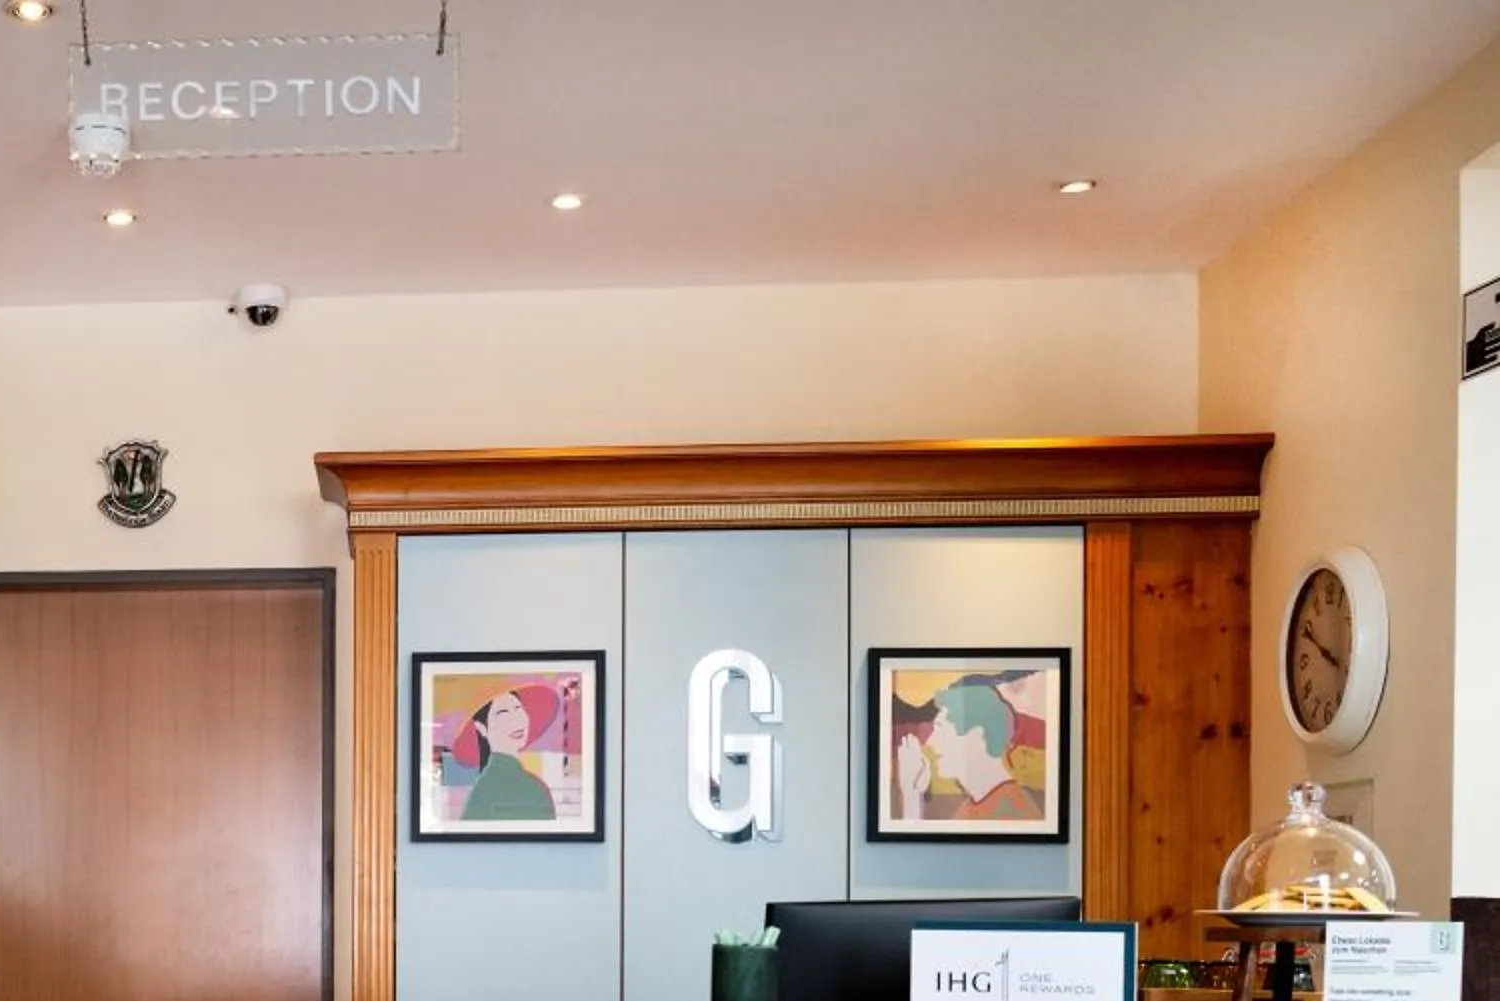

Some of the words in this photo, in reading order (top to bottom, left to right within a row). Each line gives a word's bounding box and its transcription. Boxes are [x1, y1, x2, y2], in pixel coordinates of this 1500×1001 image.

[100, 75, 421, 121] RECEPTION
[688, 649, 781, 841] G
[936, 971, 991, 993] IHG
[1019, 973, 1053, 983] ONE
[1019, 985, 1096, 995] REWARDS
